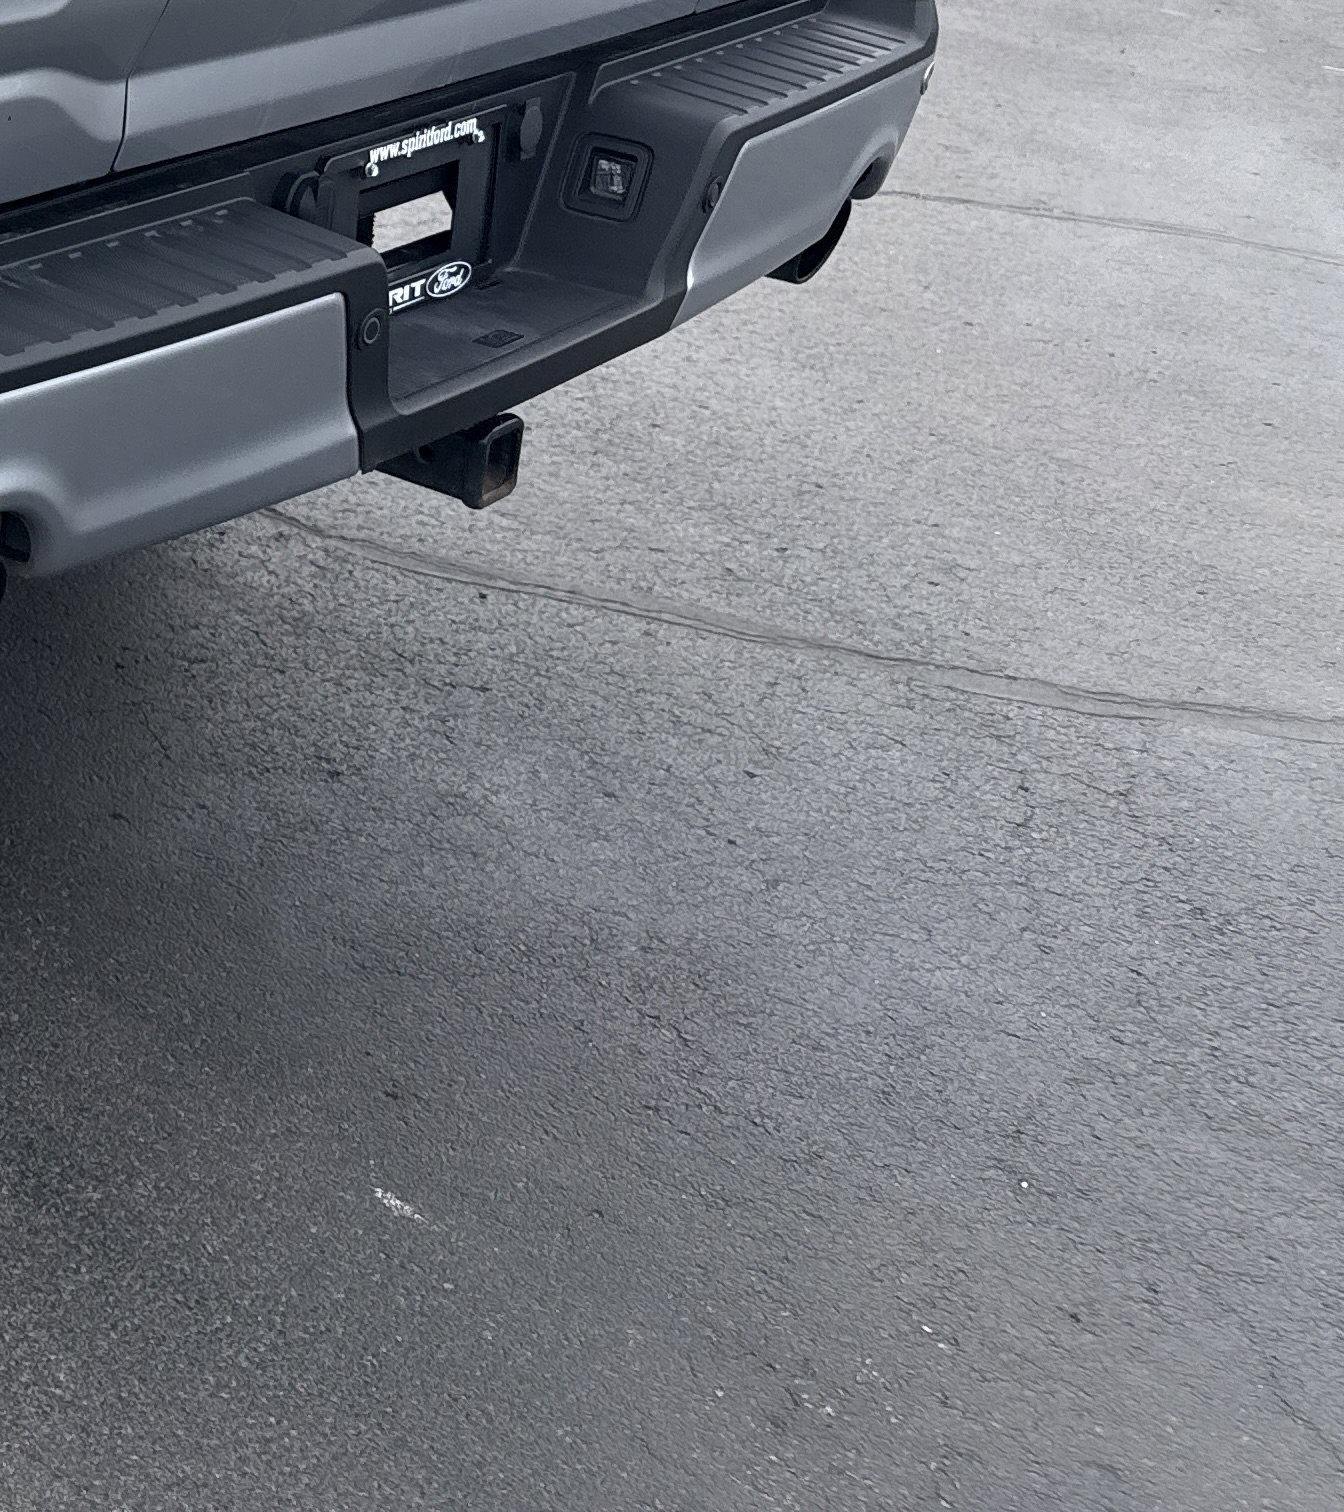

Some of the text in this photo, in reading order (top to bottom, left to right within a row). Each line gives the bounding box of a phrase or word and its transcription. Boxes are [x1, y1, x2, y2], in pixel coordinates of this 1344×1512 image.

[369, 117, 479, 163] www.spiritford.com
[388, 265, 465, 307] RIT Ford
